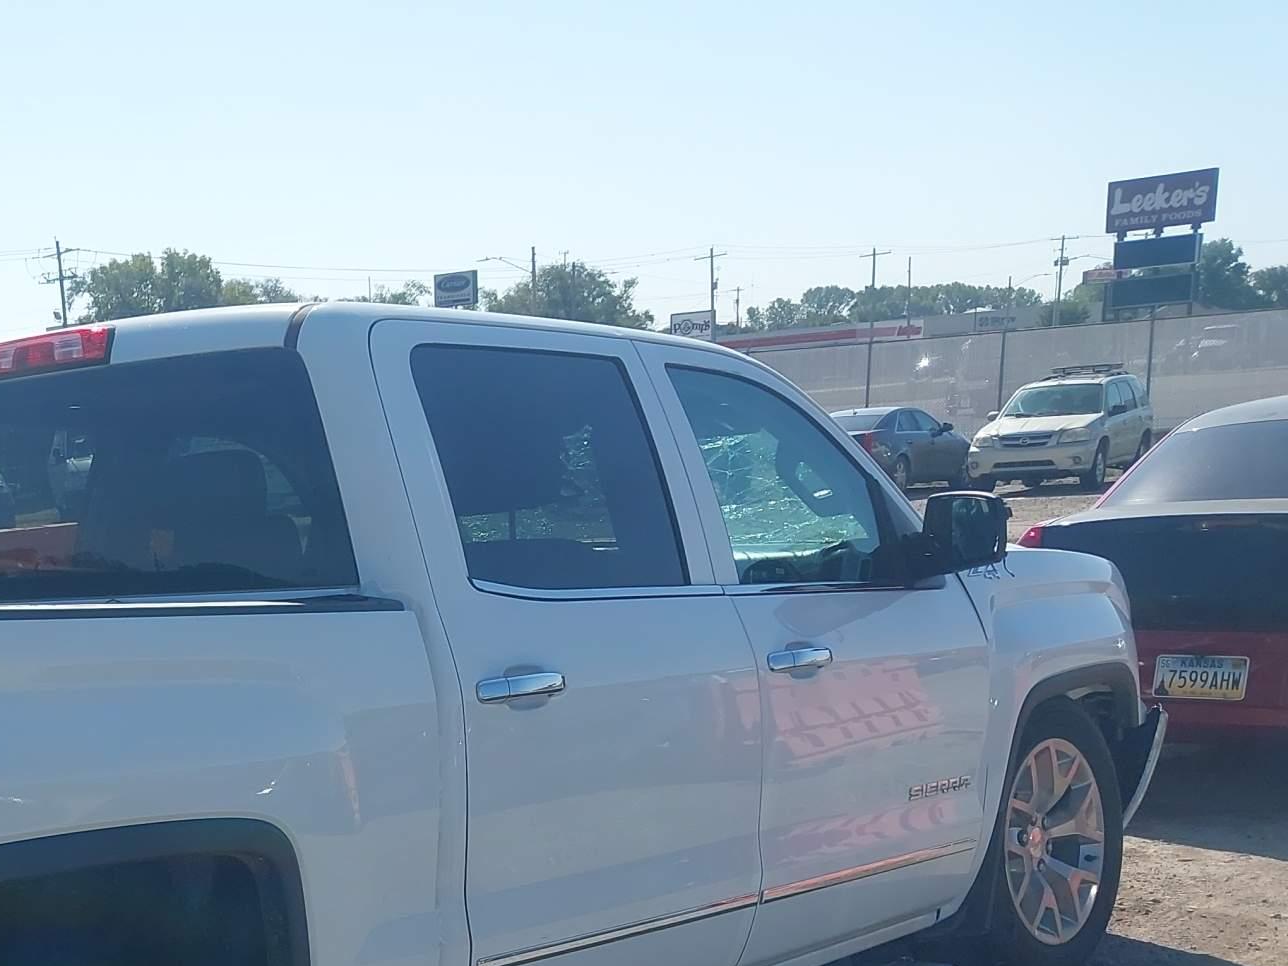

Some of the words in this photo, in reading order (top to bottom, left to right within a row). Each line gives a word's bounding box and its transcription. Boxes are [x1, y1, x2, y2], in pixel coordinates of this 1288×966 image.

[1110, 181, 1210, 215] Leeker's
[1114, 214, 1158, 227] FAMILY
[1161, 208, 1203, 222] FOODS
[1180, 659, 1224, 669] KANSAS
[1168, 669, 1242, 691] 7599AHW
[908, 775, 971, 801] SIERRA
